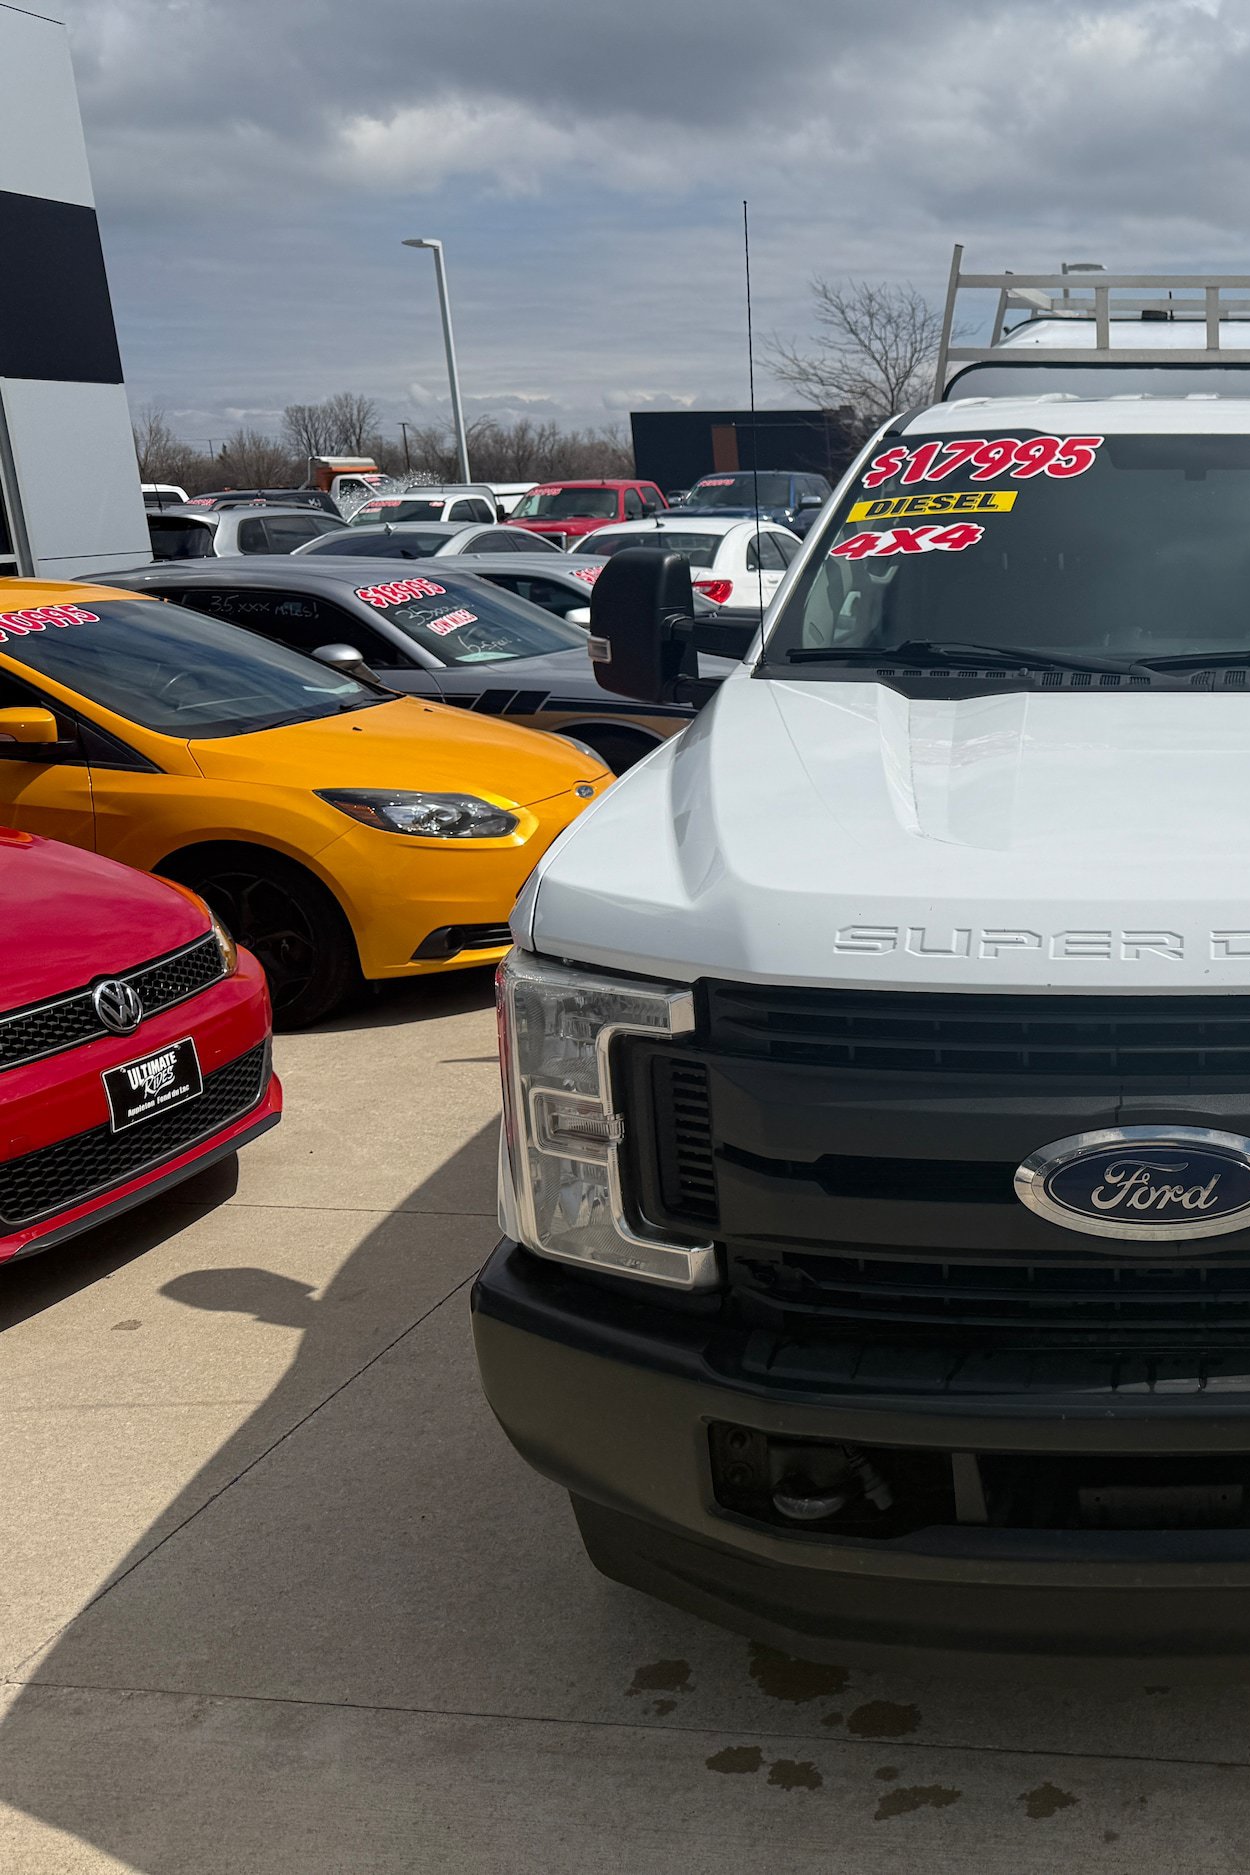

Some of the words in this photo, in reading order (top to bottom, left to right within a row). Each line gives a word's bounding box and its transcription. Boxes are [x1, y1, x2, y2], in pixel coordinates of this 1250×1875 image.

[862, 436, 1104, 488] $17995
[865, 493, 999, 519] DIESEL
[829, 523, 985, 560] 4X4
[356, 577, 446, 609] $18995
[0, 604, 100, 642] 10995
[833, 924, 1185, 960] SUPER
[127, 1051, 177, 1091] ULTIMATE
[128, 1100, 155, 1117] Appleton
[157, 1092, 171, 1104] Fond
[171, 1089, 179, 1098] du
[179, 1084, 190, 1094] Lac
[1091, 1160, 1221, 1209] Ford
